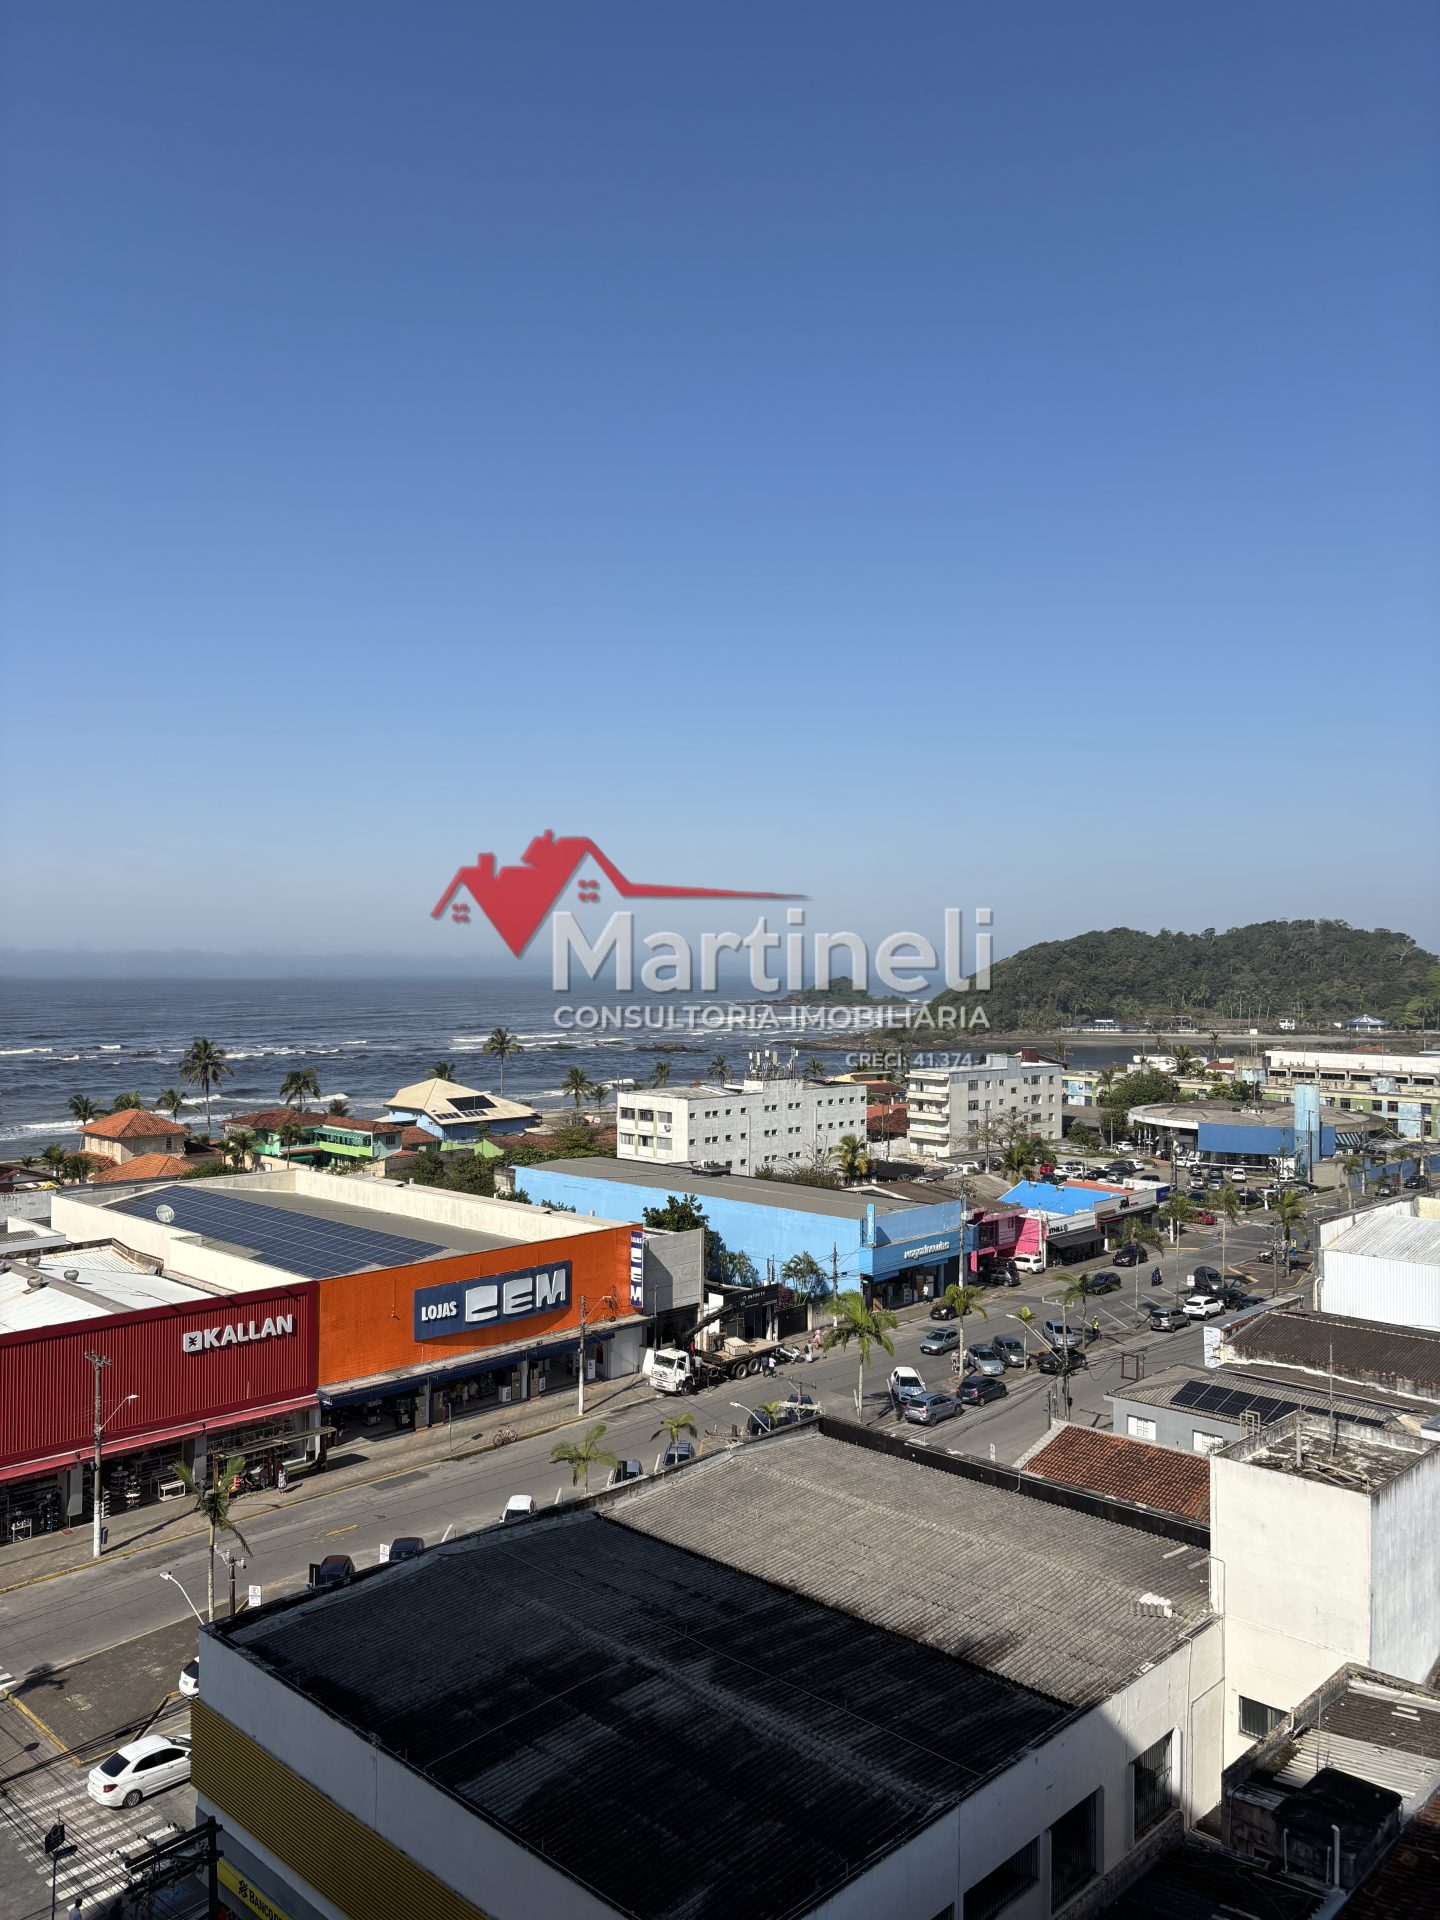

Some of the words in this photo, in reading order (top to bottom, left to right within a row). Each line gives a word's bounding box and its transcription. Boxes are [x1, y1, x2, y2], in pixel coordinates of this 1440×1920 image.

[421, 1301, 457, 1322] LOJAS
[465, 1268, 566, 1323] CEM
[204, 1313, 293, 1349] KALLAN
